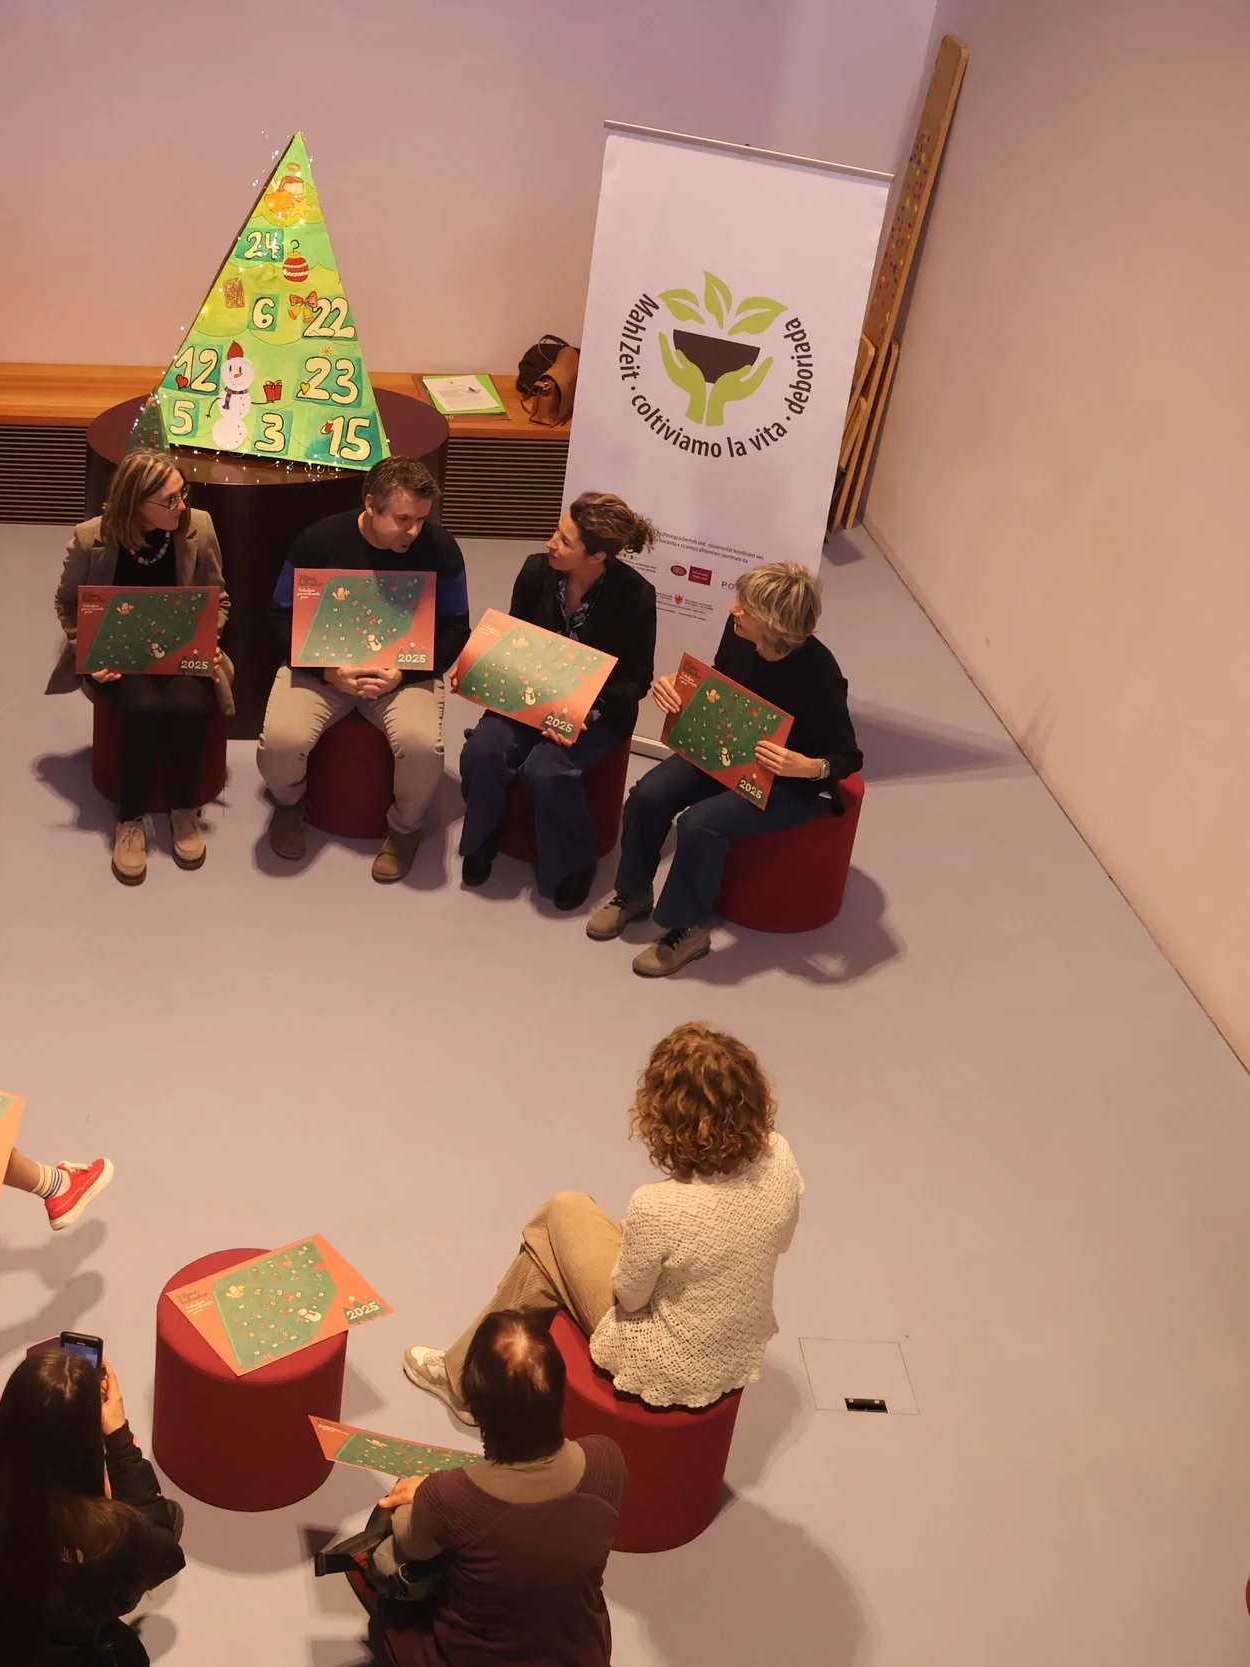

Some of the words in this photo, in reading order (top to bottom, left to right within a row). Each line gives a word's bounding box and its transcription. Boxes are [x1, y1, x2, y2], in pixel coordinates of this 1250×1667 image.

[244, 230, 280, 260] 24
[252, 297, 276, 329] 6
[302, 297, 356, 339] 22
[174, 346, 220, 392] 12
[295, 356, 360, 405] 23
[169, 399, 197, 436] 5
[254, 412, 286, 453] 3
[631, 394, 722, 458] coltiviamo
[727, 436, 747, 458] la
[749, 422, 788, 451] vita
[320, 415, 372, 461] 15
[181, 660, 209, 670] 2025
[398, 653, 427, 664] 2025
[545, 715, 574, 733] 2025
[739, 779, 763, 799] 2025
[345, 1301, 380, 1320] 2025
